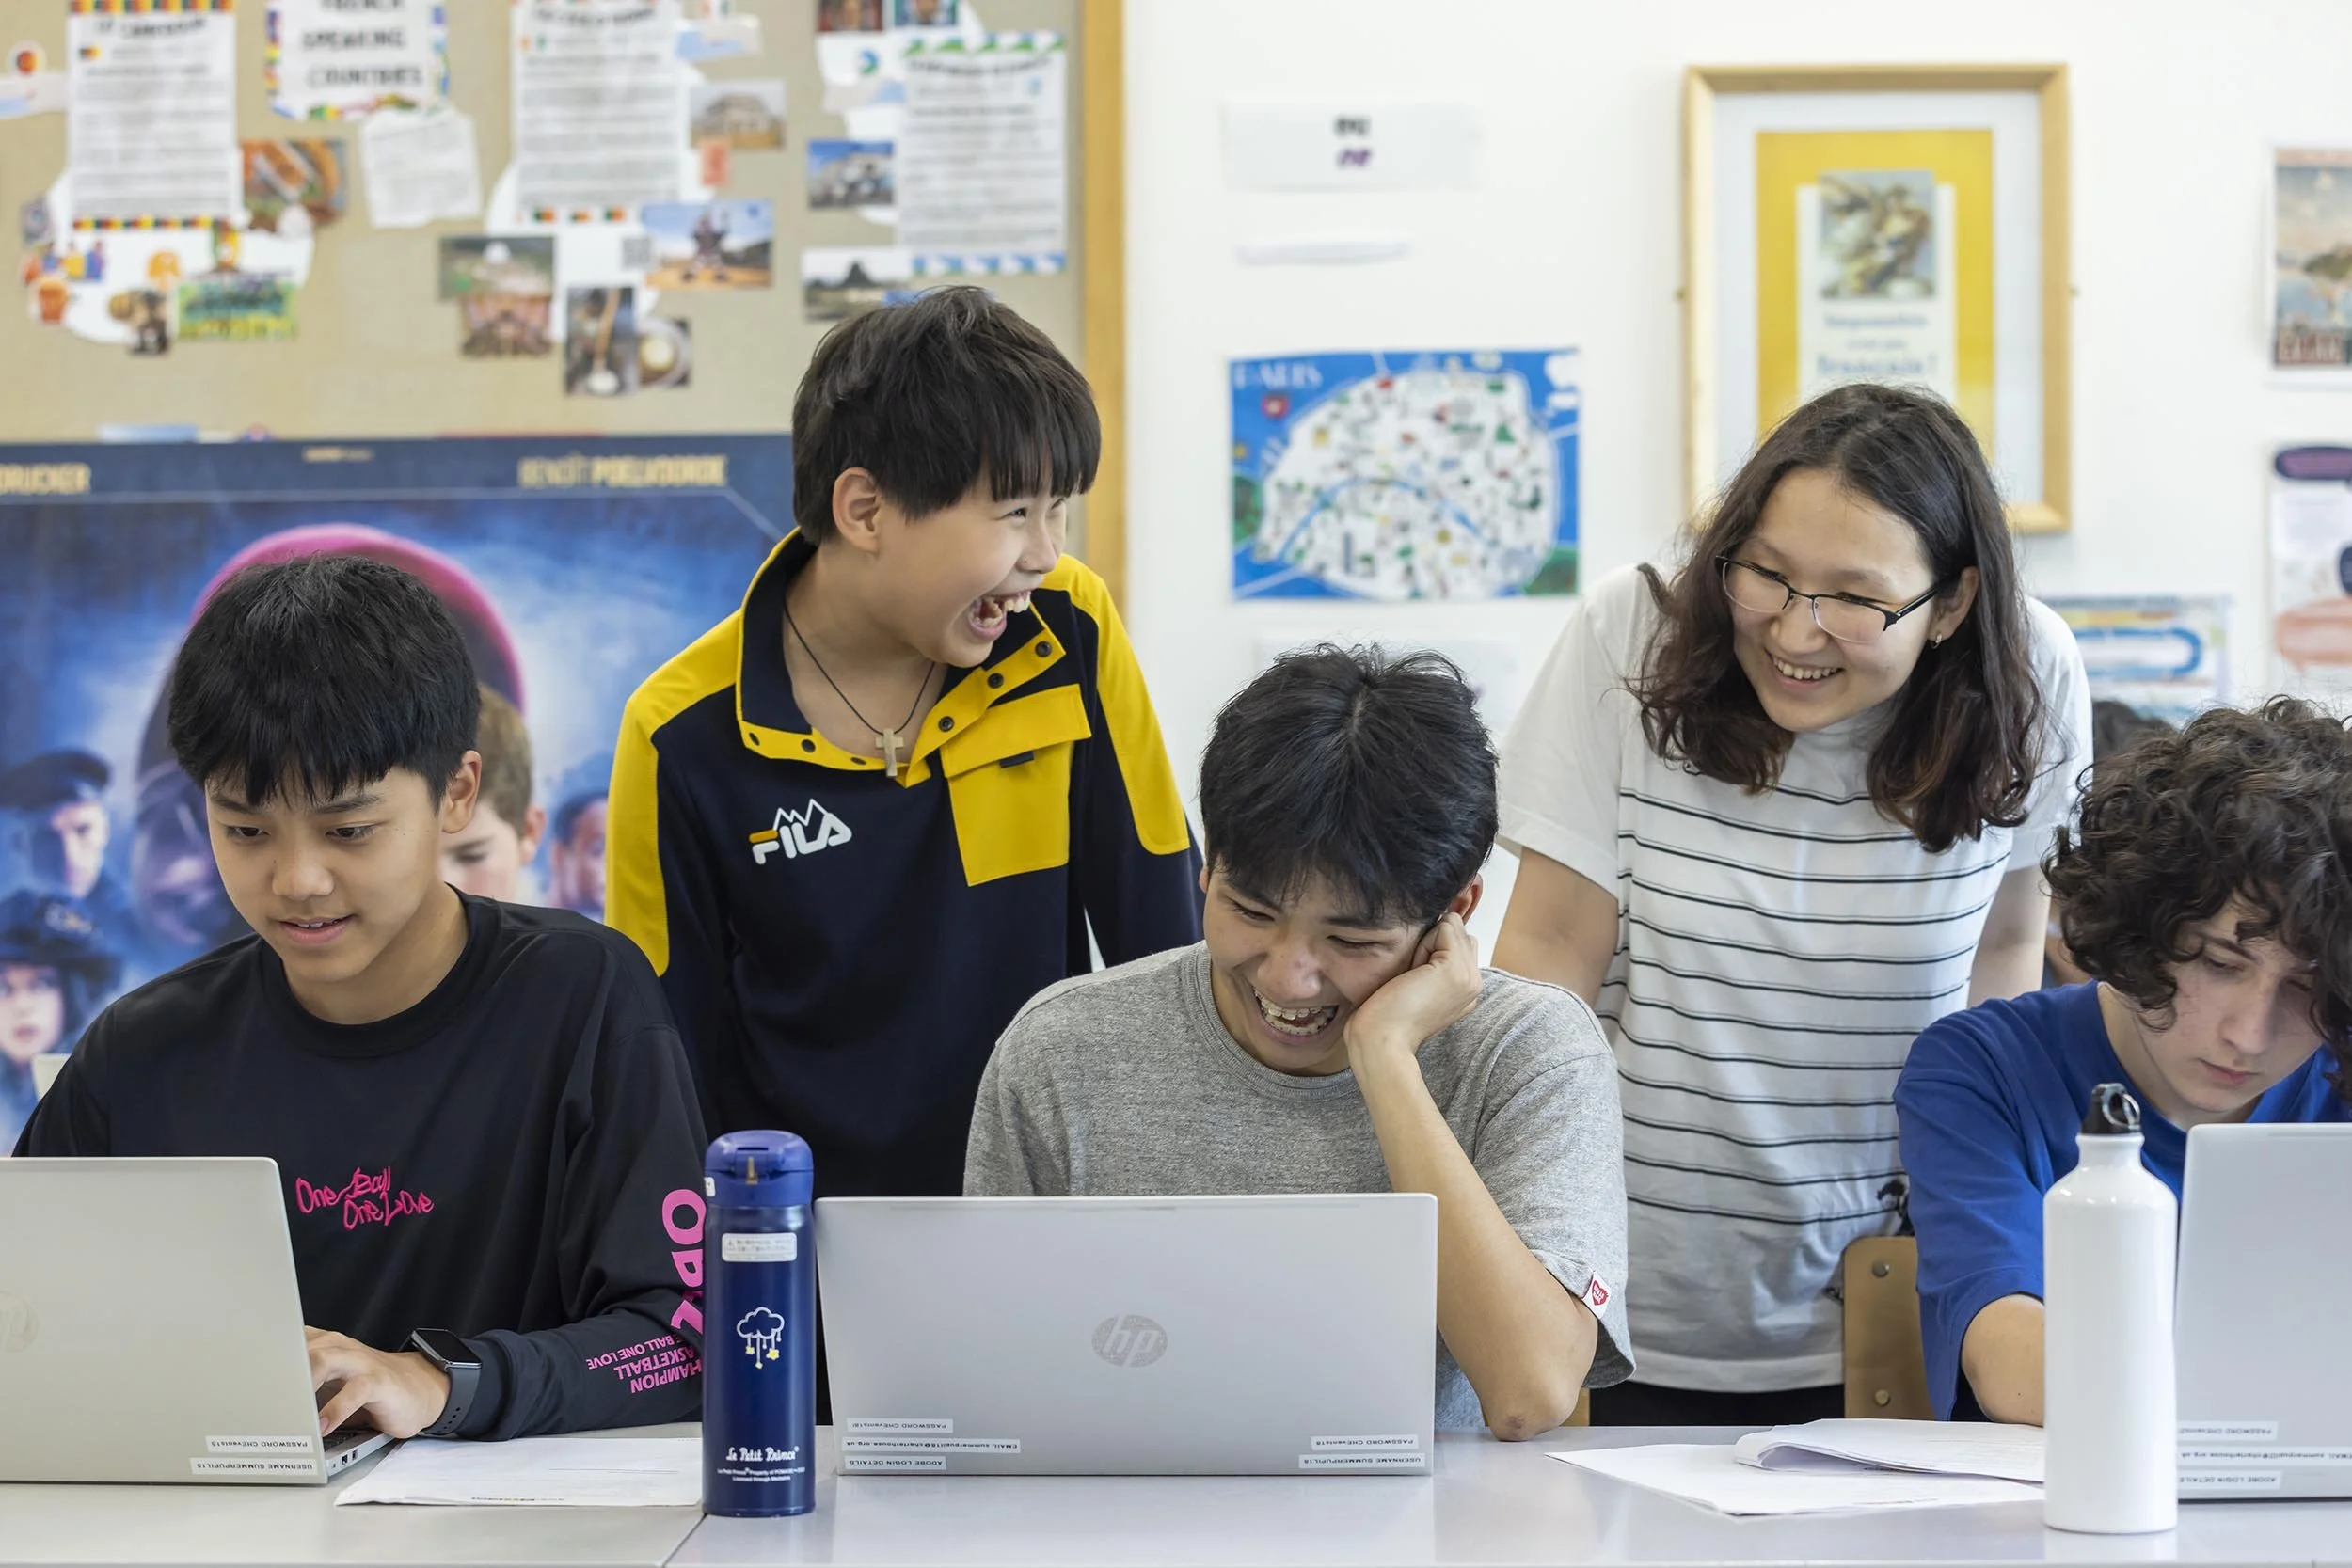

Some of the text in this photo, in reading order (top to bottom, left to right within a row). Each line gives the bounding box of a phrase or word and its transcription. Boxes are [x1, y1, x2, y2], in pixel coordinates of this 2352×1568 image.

[749, 809, 852, 864] FILA
[295, 1178, 338, 1212] One
[344, 1199, 383, 1229] One
[617, 1343, 645, 1360] ONE
[644, 1336, 675, 1351] BALL
[1092, 1315, 1168, 1368] hp
[586, 1352, 618, 1370] LOVE
[613, 1345, 697, 1380] ASKETBALL
[630, 1358, 703, 1393] HAMPION
